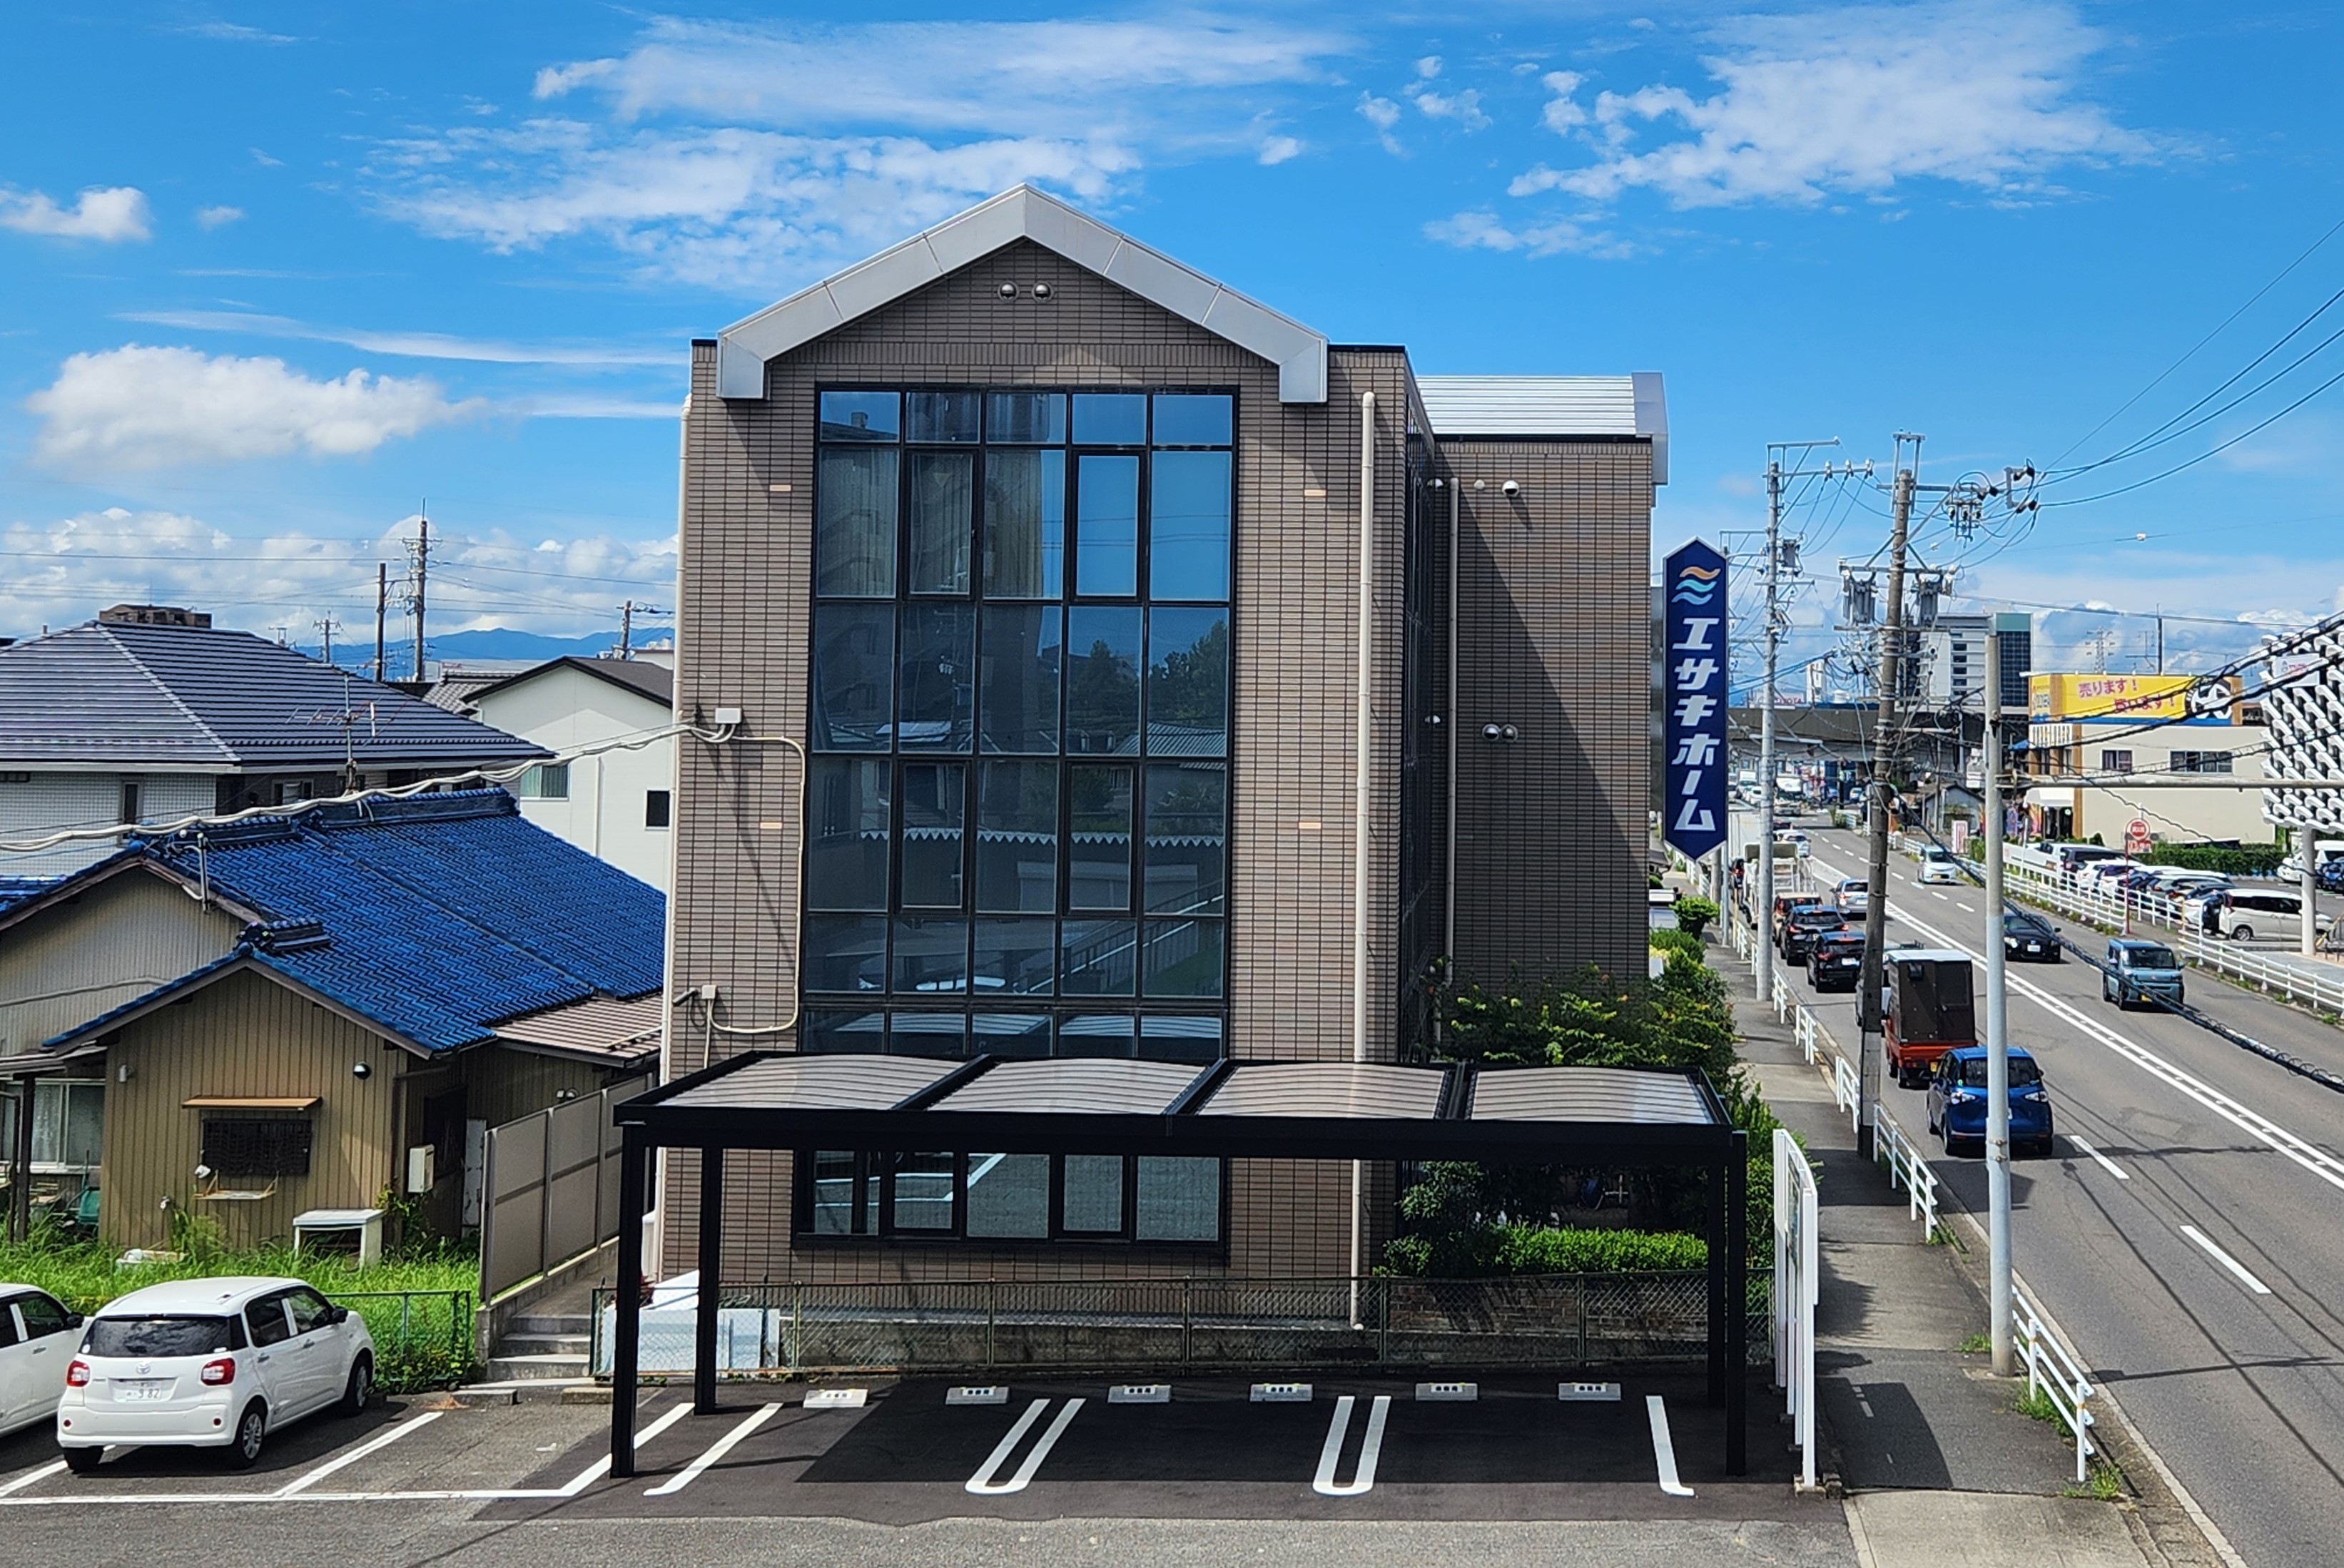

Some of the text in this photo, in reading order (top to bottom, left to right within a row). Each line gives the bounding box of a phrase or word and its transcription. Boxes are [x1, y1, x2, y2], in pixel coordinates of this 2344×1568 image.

[1671, 618, 1720, 831] エサキホーム
